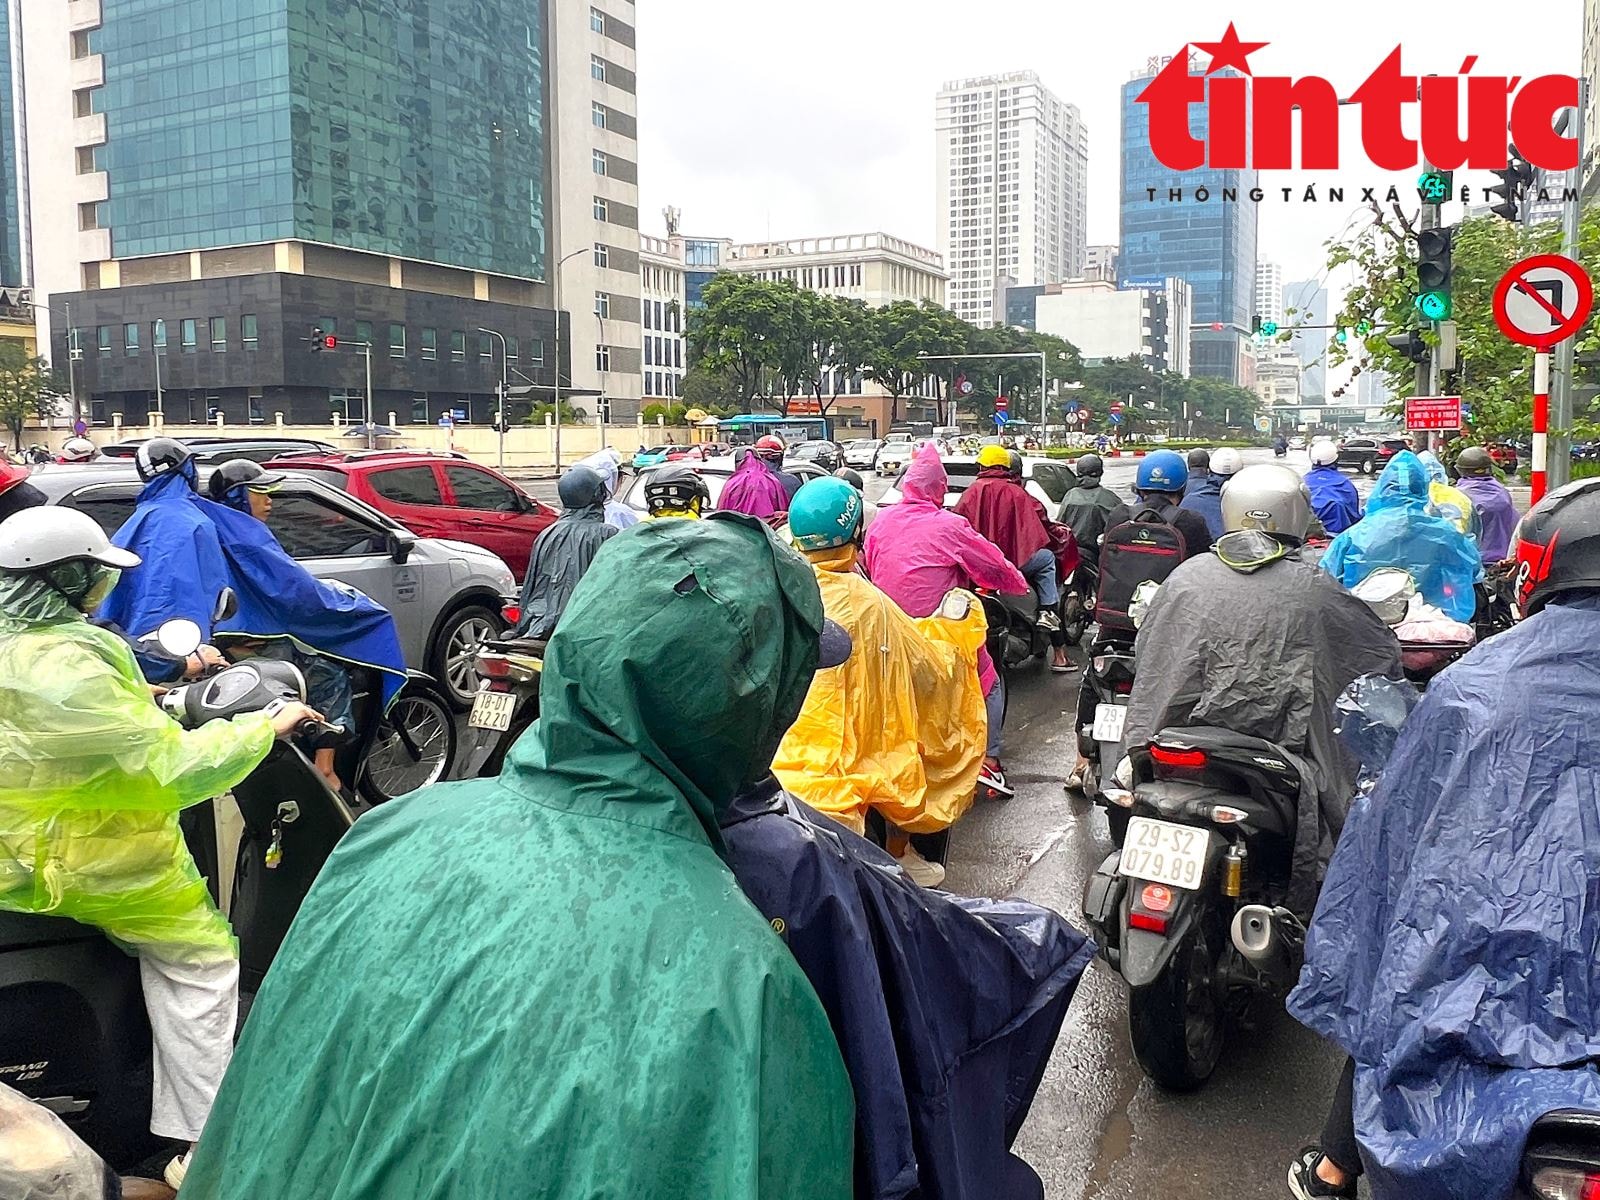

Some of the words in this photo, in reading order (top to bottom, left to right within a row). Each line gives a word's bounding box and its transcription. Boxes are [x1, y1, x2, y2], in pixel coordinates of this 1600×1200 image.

[1097, 723, 1120, 739] 411
[1137, 823, 1195, 855] 29-S2
[1126, 848, 1196, 884] 079.89
